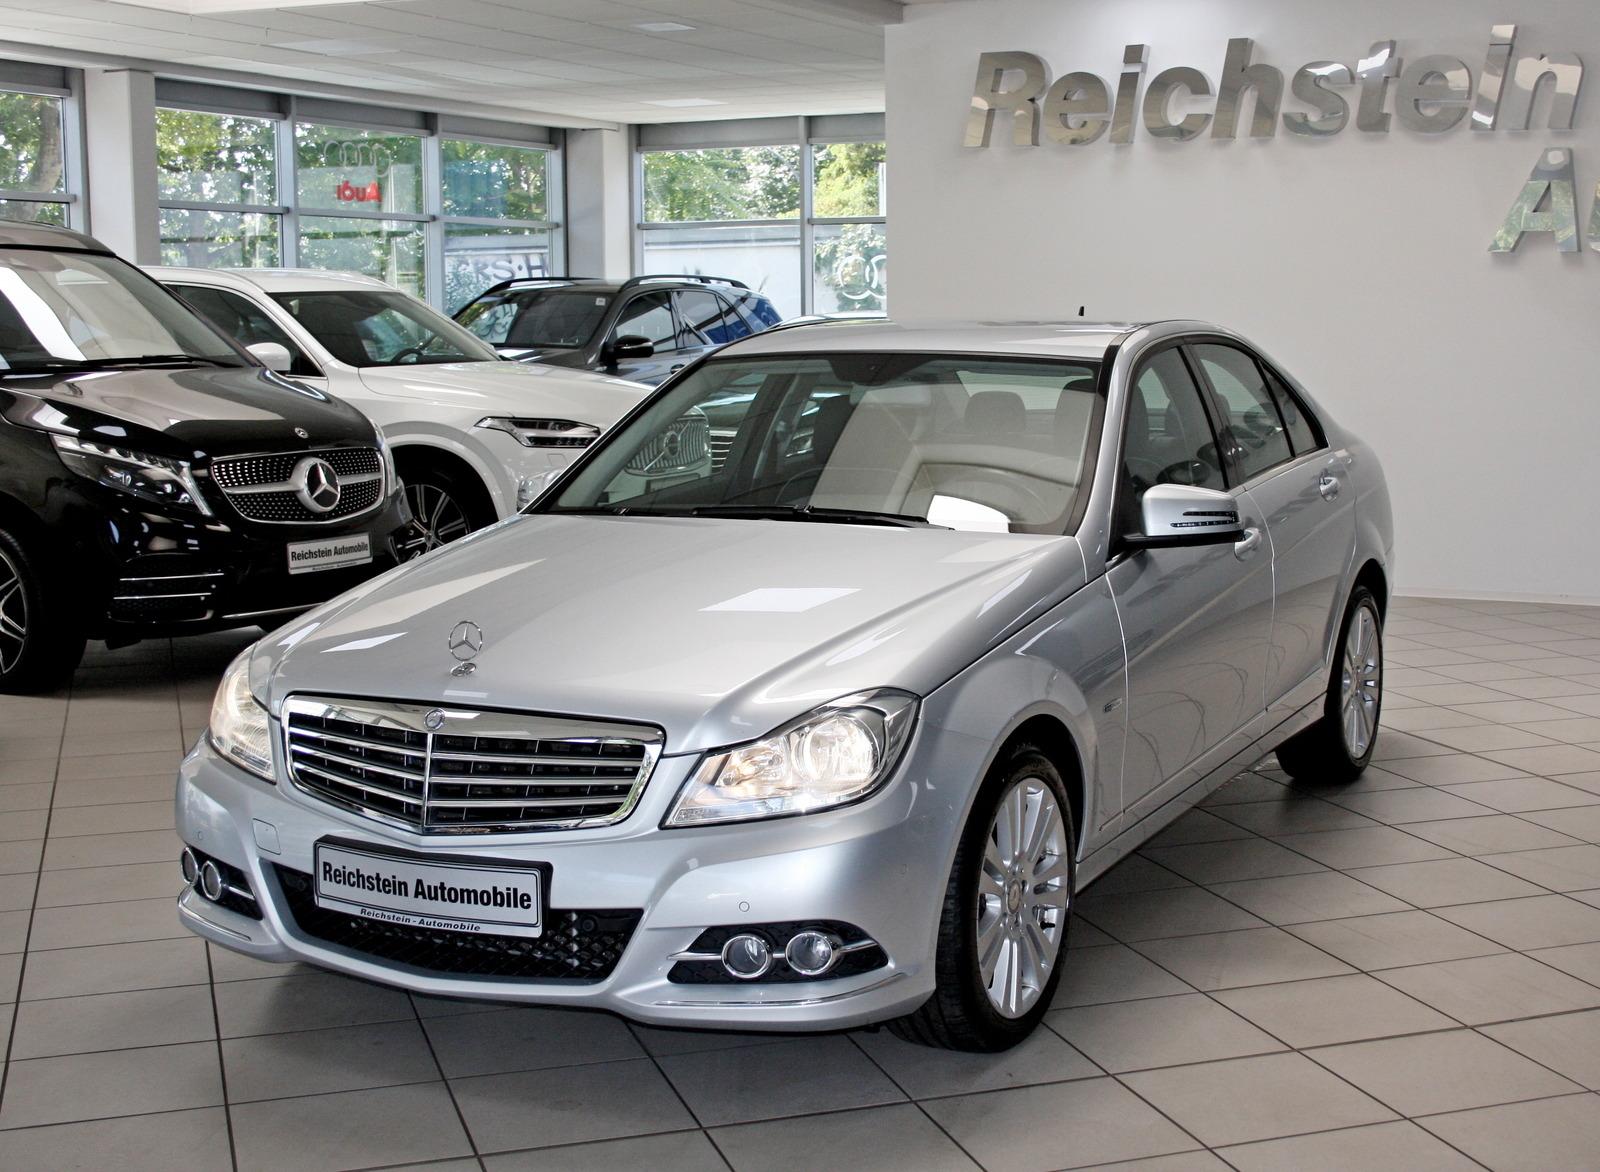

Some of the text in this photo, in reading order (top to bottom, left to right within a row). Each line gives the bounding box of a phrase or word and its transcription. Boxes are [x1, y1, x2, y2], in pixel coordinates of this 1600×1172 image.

[963, 24, 1586, 148] Reichstein
[1487, 147, 1600, 253] A
[291, 542, 369, 561] Reichstein Automobile
[322, 861, 532, 910] Reichstein Automobile
[360, 908, 411, 924] Reichstein
[418, 918, 481, 932] Automobile
